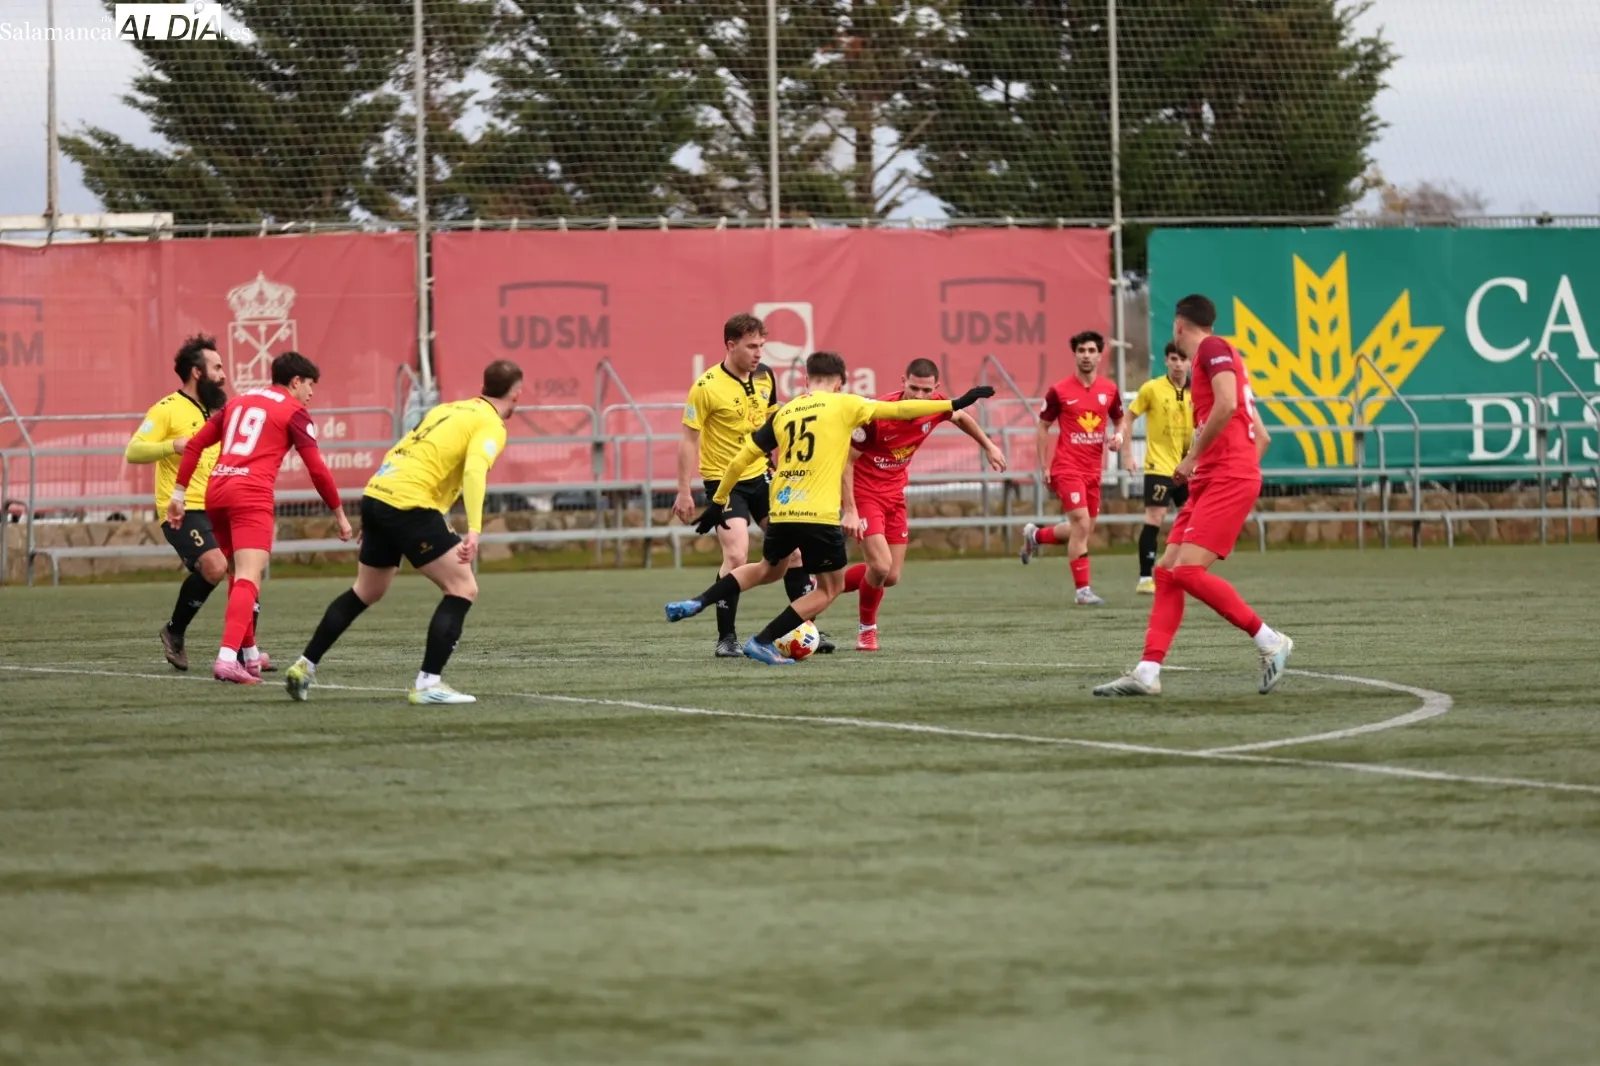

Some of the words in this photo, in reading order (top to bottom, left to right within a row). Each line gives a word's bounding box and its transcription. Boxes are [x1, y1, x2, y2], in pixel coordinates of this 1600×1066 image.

[500, 315, 610, 349] UDSM
[941, 310, 1045, 344] UDSM
[1465, 274, 1600, 386] CA
[795, 402, 826, 413] Mojados
[222, 405, 267, 457] 19
[323, 416, 346, 438] de
[783, 415, 818, 463] 15
[1152, 484, 1167, 501] 27
[788, 509, 818, 518] Mojados
[190, 529, 205, 548] 3
